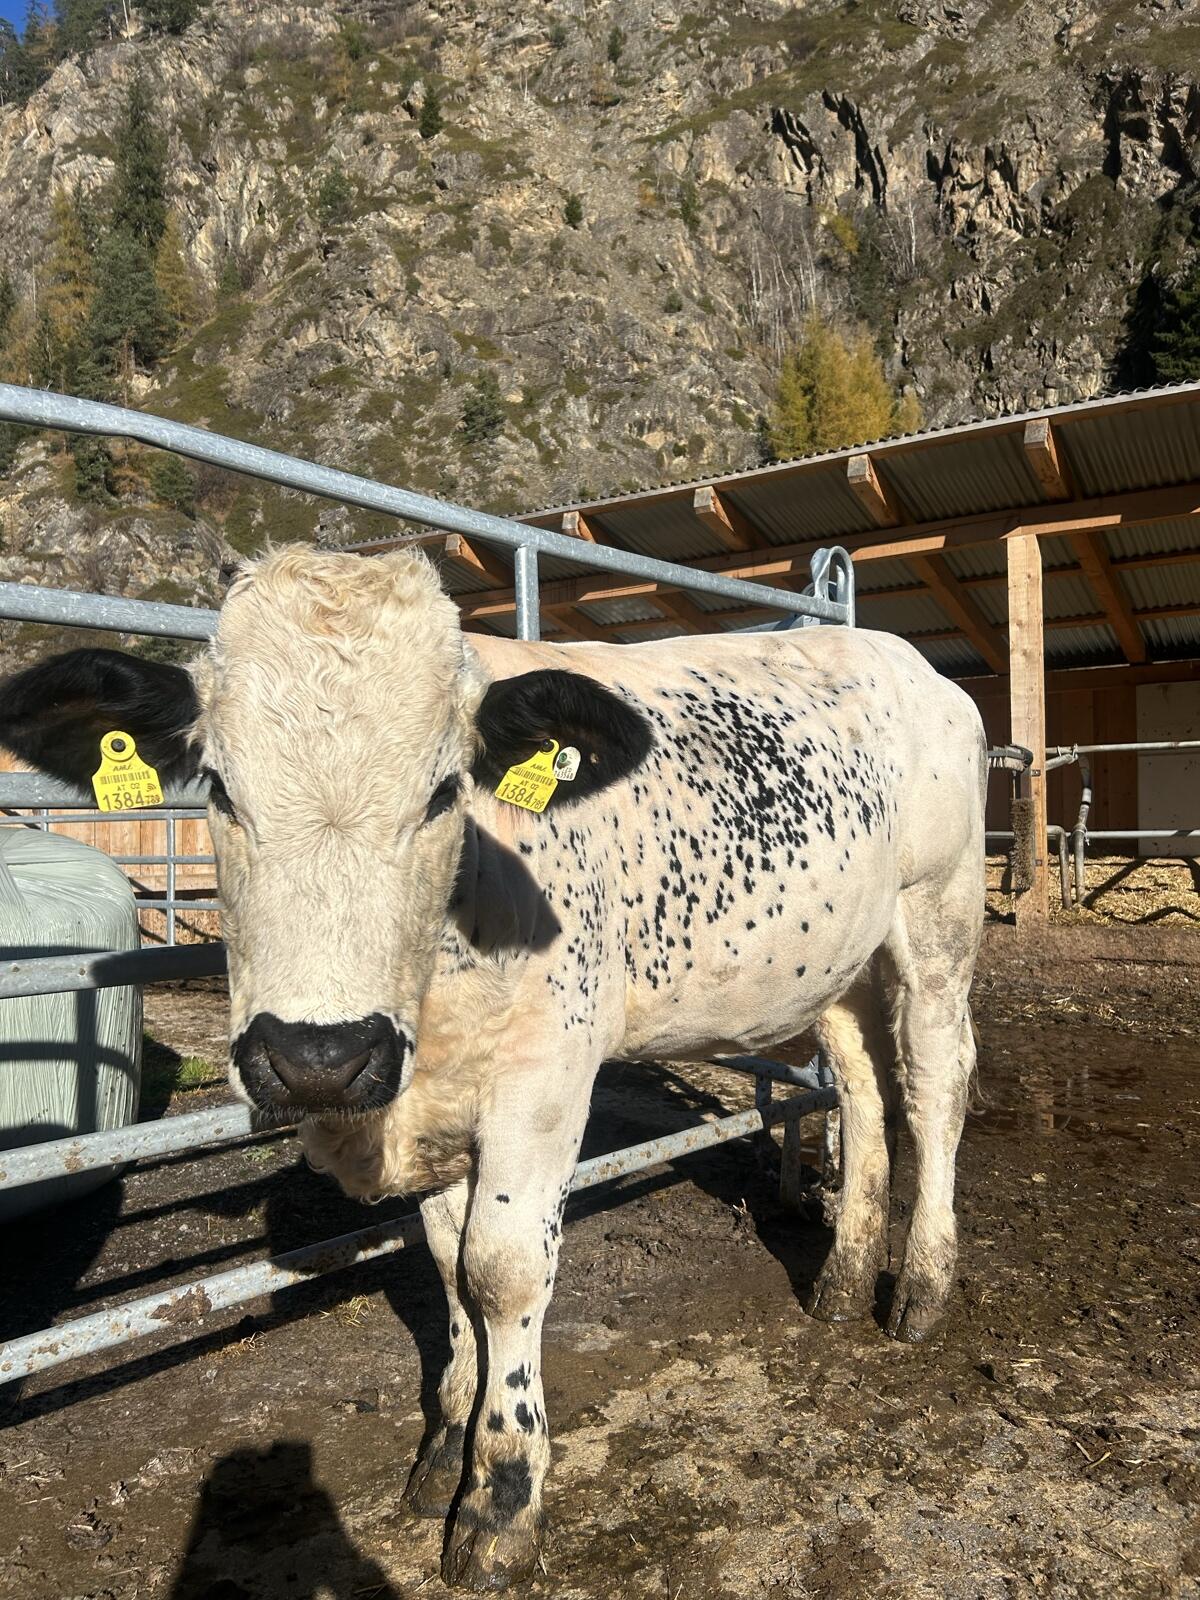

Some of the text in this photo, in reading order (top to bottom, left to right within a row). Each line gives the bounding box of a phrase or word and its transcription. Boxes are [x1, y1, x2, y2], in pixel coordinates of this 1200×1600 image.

[117, 784, 126, 792] AT
[519, 779, 540, 791] AT 02
